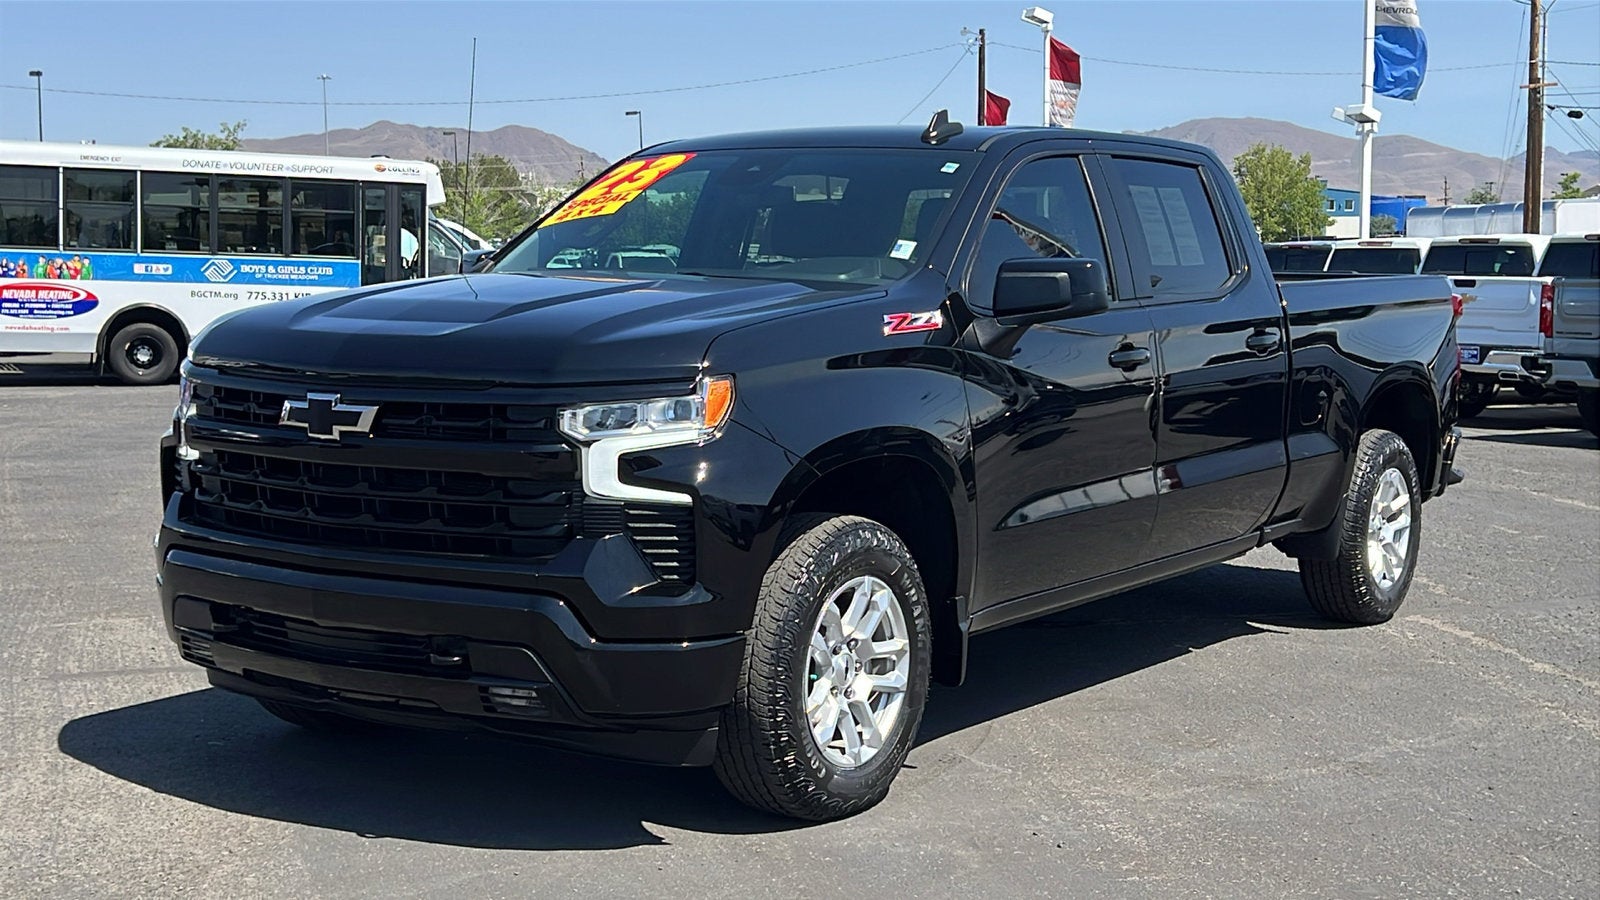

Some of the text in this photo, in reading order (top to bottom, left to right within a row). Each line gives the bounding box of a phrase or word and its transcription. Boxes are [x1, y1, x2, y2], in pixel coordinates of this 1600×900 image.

[79, 154, 110, 162] EMERGENCY
[182, 158, 335, 175] DONATE VOLUNTEER SUPPORT
[387, 166, 421, 174] COLLINS
[240, 264, 334, 276] BOYS & GIRLS CLUB
[2, 289, 74, 300] NEVADA HEATING
[190, 290, 239, 301] BGCTM.org
[4, 324, 70, 332] nevadaheating.com
